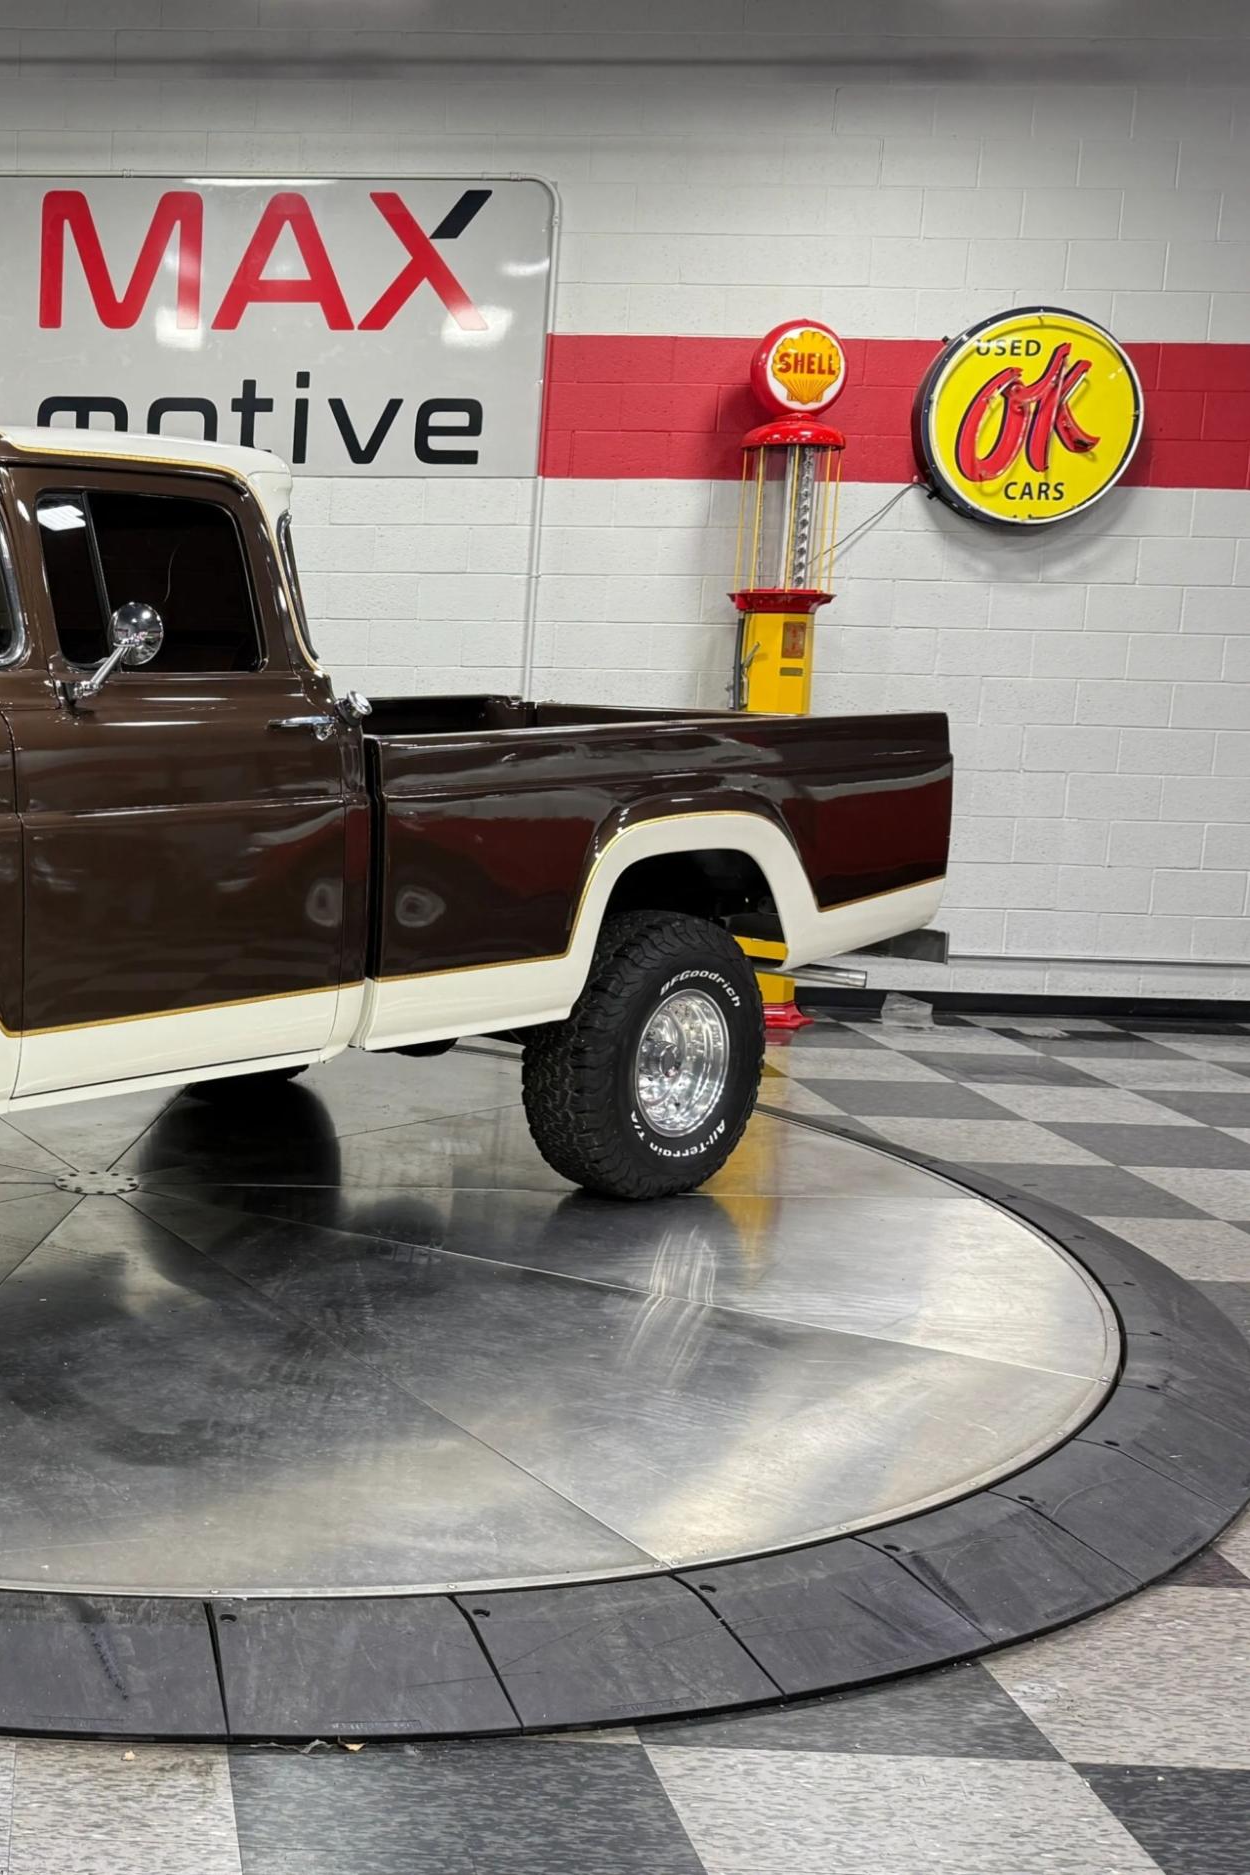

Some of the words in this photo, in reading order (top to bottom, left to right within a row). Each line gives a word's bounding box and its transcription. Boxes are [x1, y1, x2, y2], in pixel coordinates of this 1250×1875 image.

[39, 189, 493, 330] MAX
[777, 351, 837, 376] SHELL
[976, 339, 1042, 357] USED
[1004, 482, 1065, 501] CARS
[660, 969, 741, 1007] BFGoodrich
[650, 1119, 726, 1157] All-Terrain
